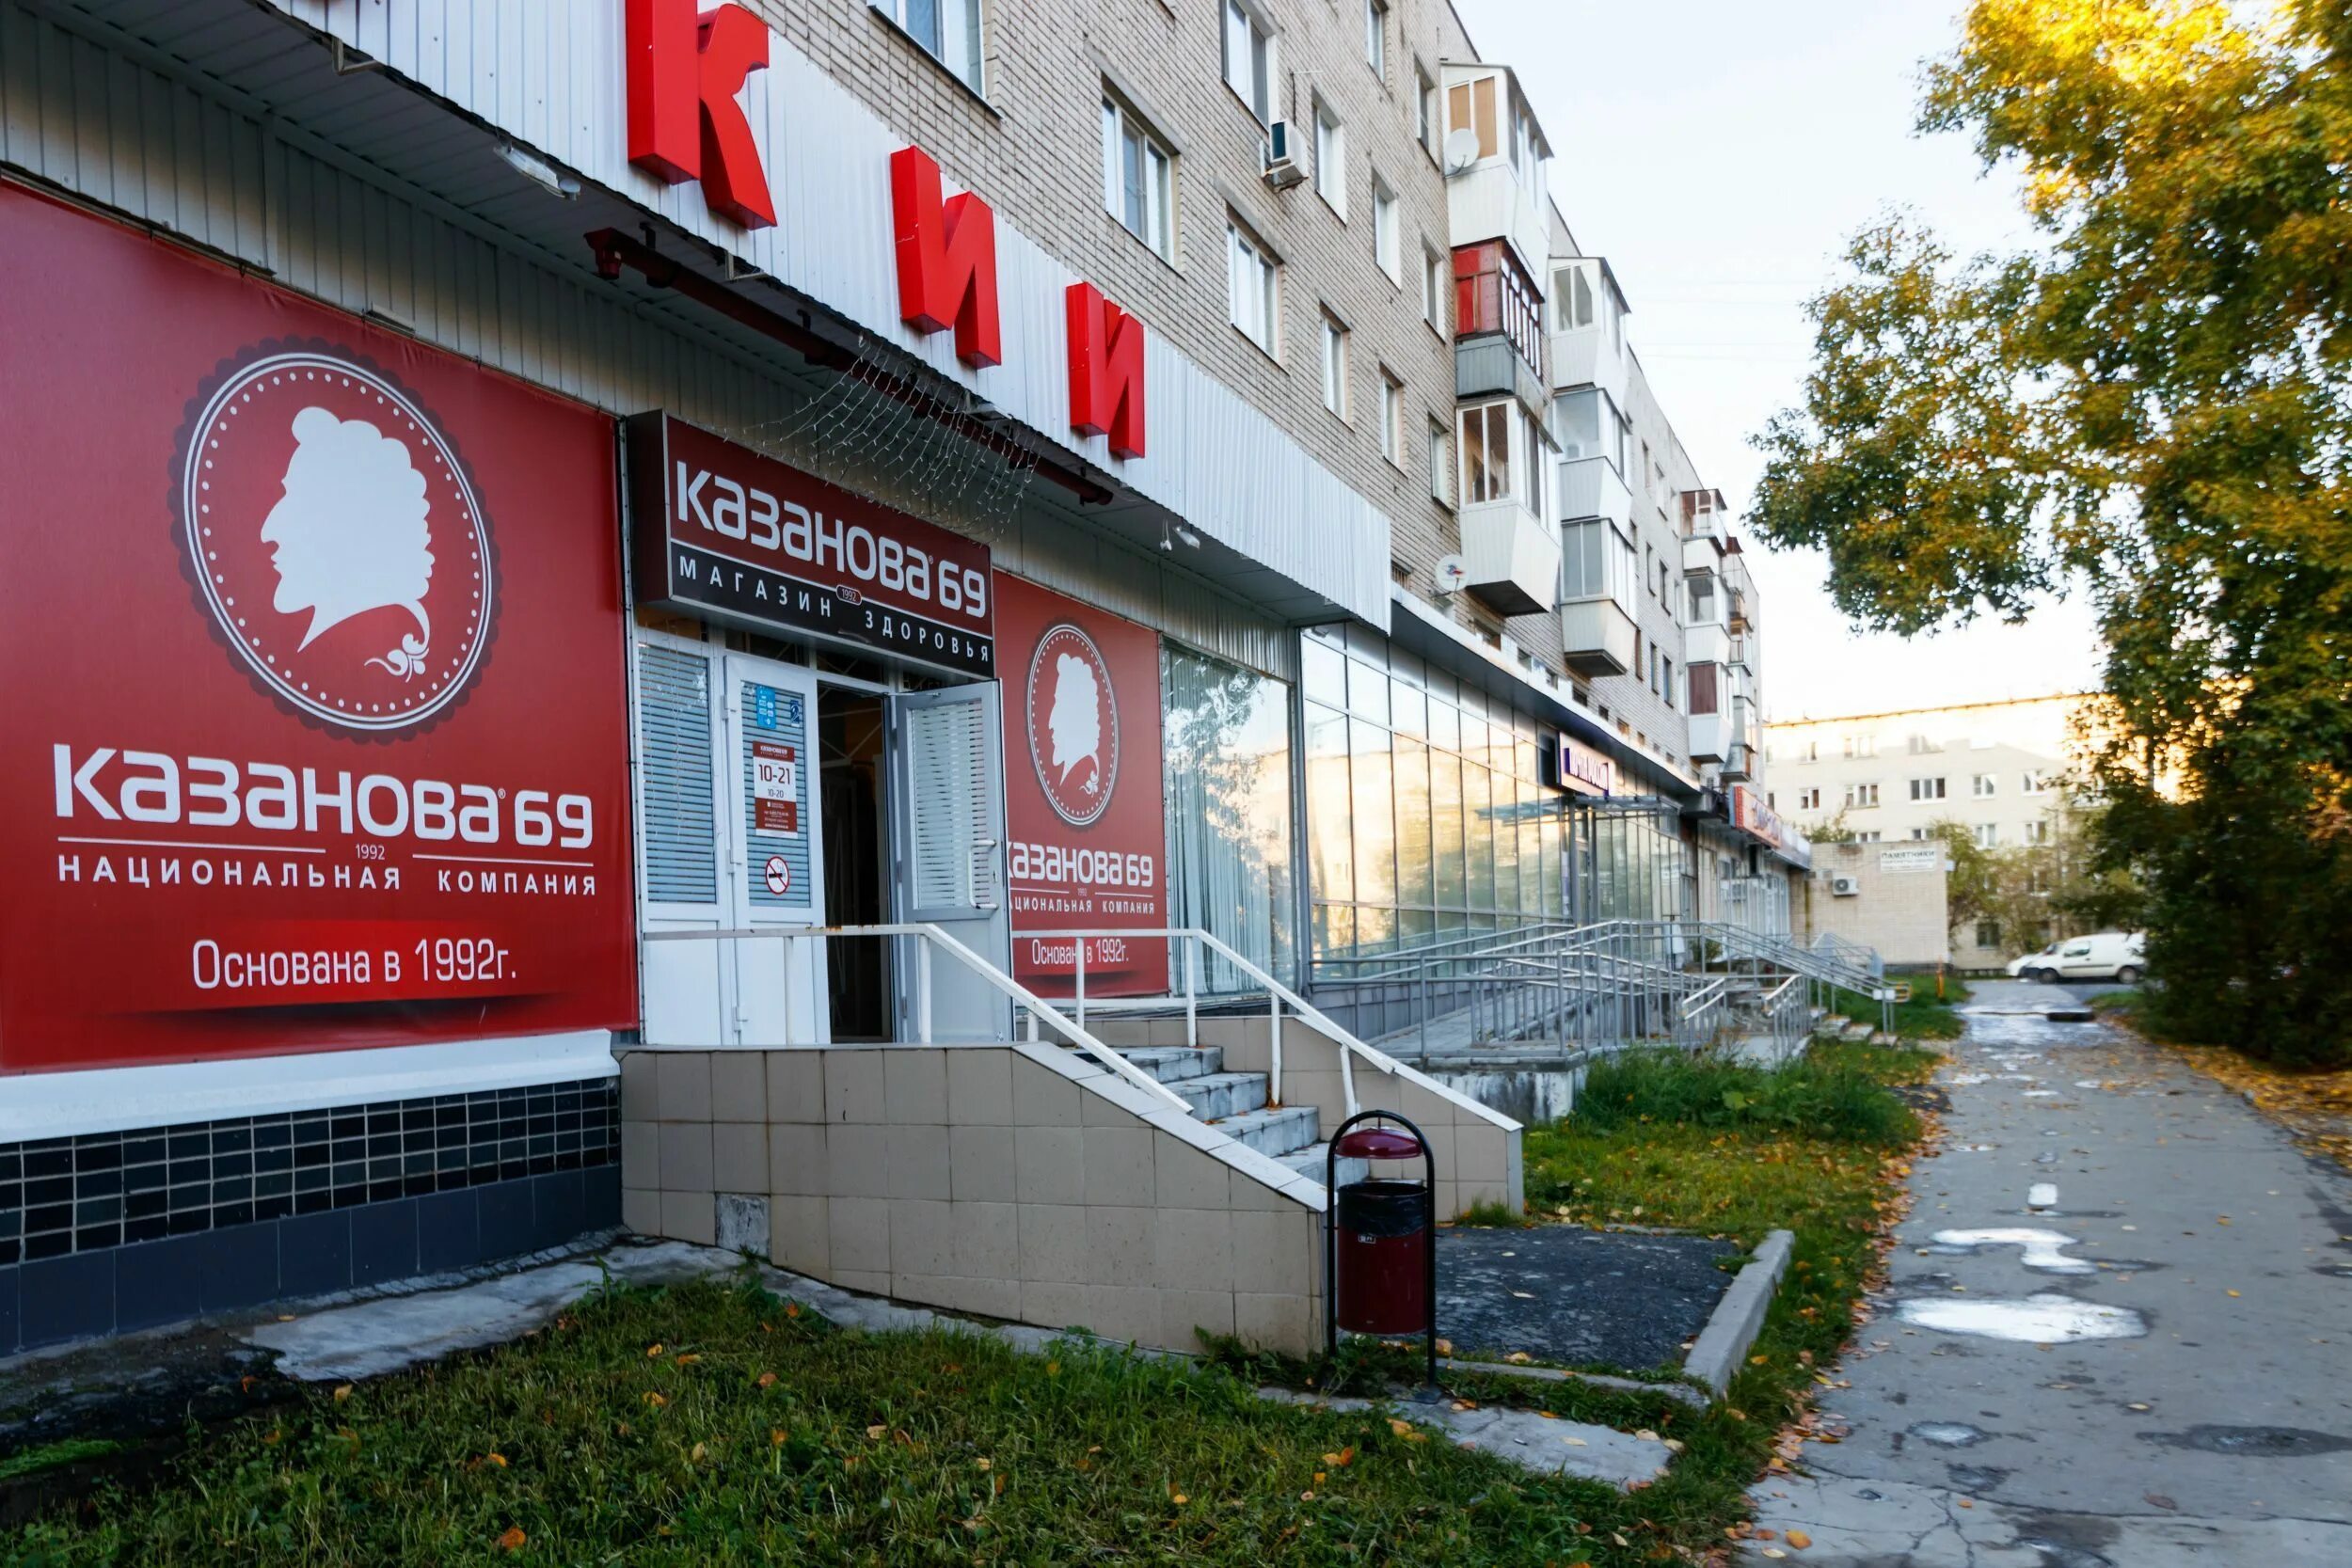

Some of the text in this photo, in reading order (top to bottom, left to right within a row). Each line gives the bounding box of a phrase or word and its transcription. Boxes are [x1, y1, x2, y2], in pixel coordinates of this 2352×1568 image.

[841, 587, 857, 603] 1992
[938, 559, 987, 620] 69
[679, 555, 989, 663] МАГАЗИН ЗДОРОВЬЯ
[758, 764, 790, 785] 10-21
[514, 789, 594, 848] 69
[356, 844, 386, 861] 1992
[57, 854, 597, 896] НАЦИОНАЛЬНАЯ КОМПАНИЯ
[1126, 854, 1153, 887] 69
[1009, 895, 1155, 914] ЦИОНАЛЬНАЯ КОМПАНИЯ
[191, 938, 517, 990] Основана в 1992г.
[1032, 939, 1077, 965] Основан
[1095, 938, 1130, 963] 1992г.
